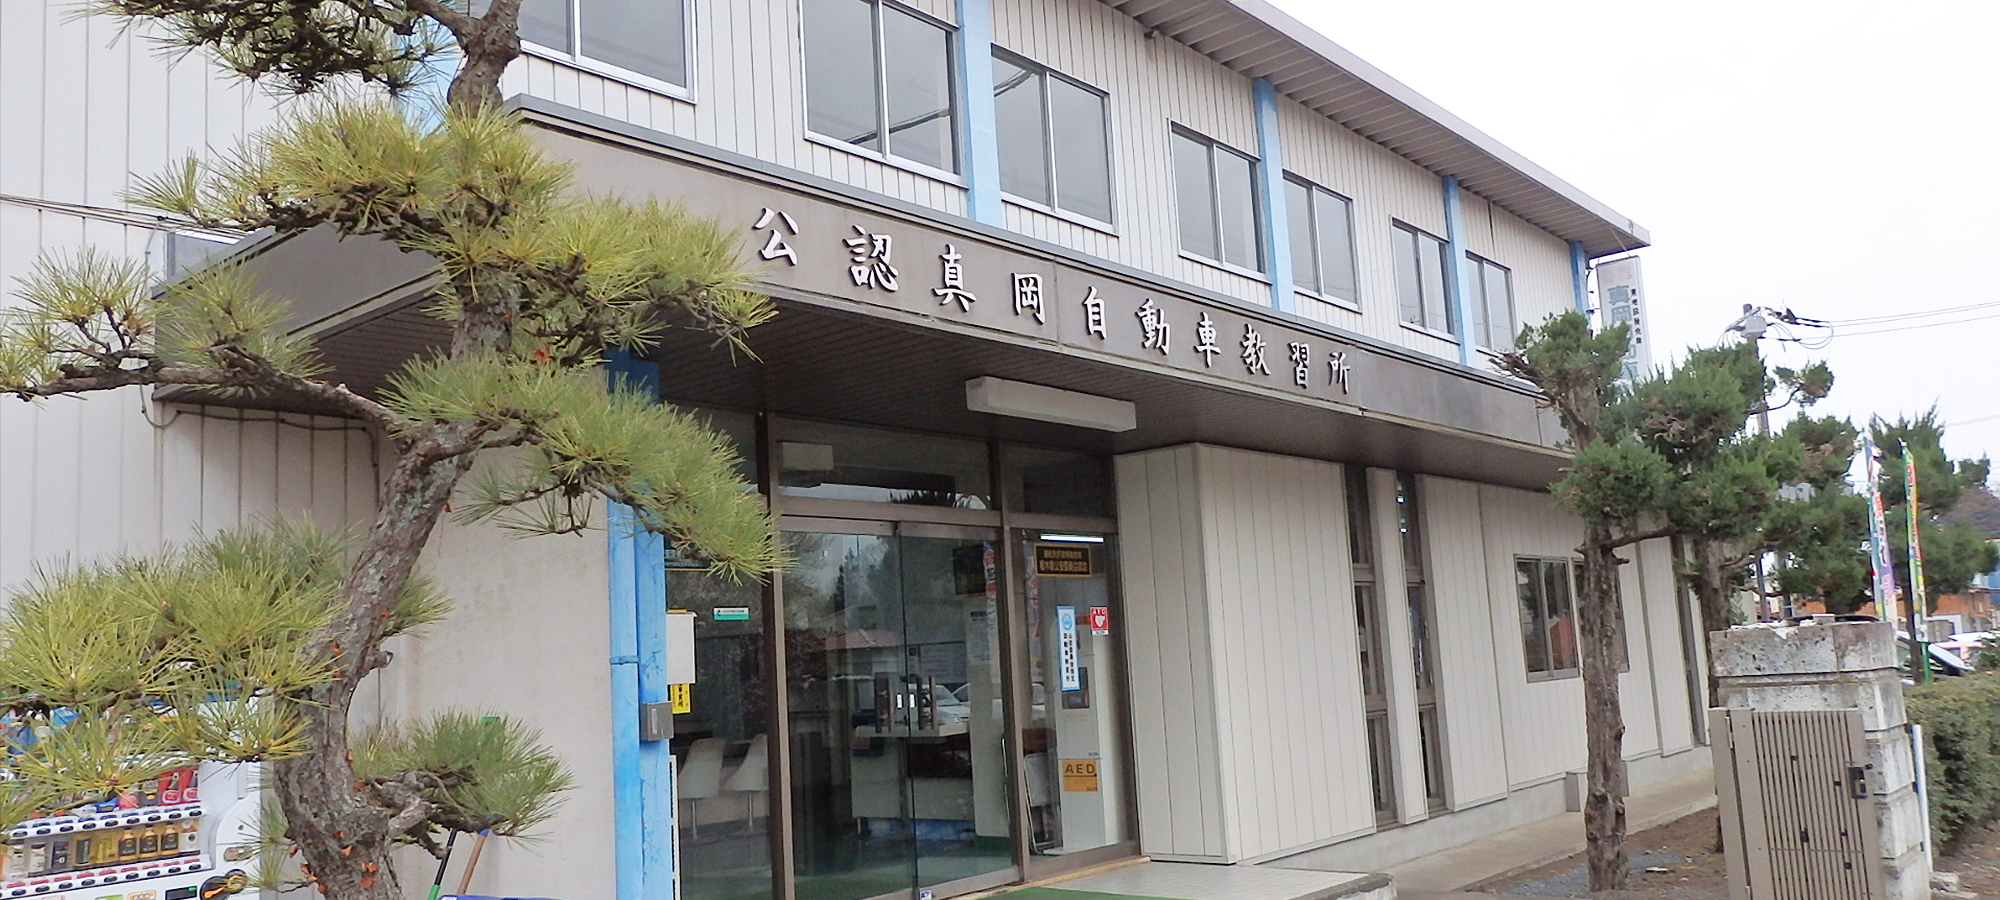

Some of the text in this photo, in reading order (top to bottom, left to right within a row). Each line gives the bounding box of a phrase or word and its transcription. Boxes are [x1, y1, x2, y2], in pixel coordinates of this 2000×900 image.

[752, 206, 1351, 394] 公認真岡自動車教習所
[1065, 763, 1095, 774] AED
